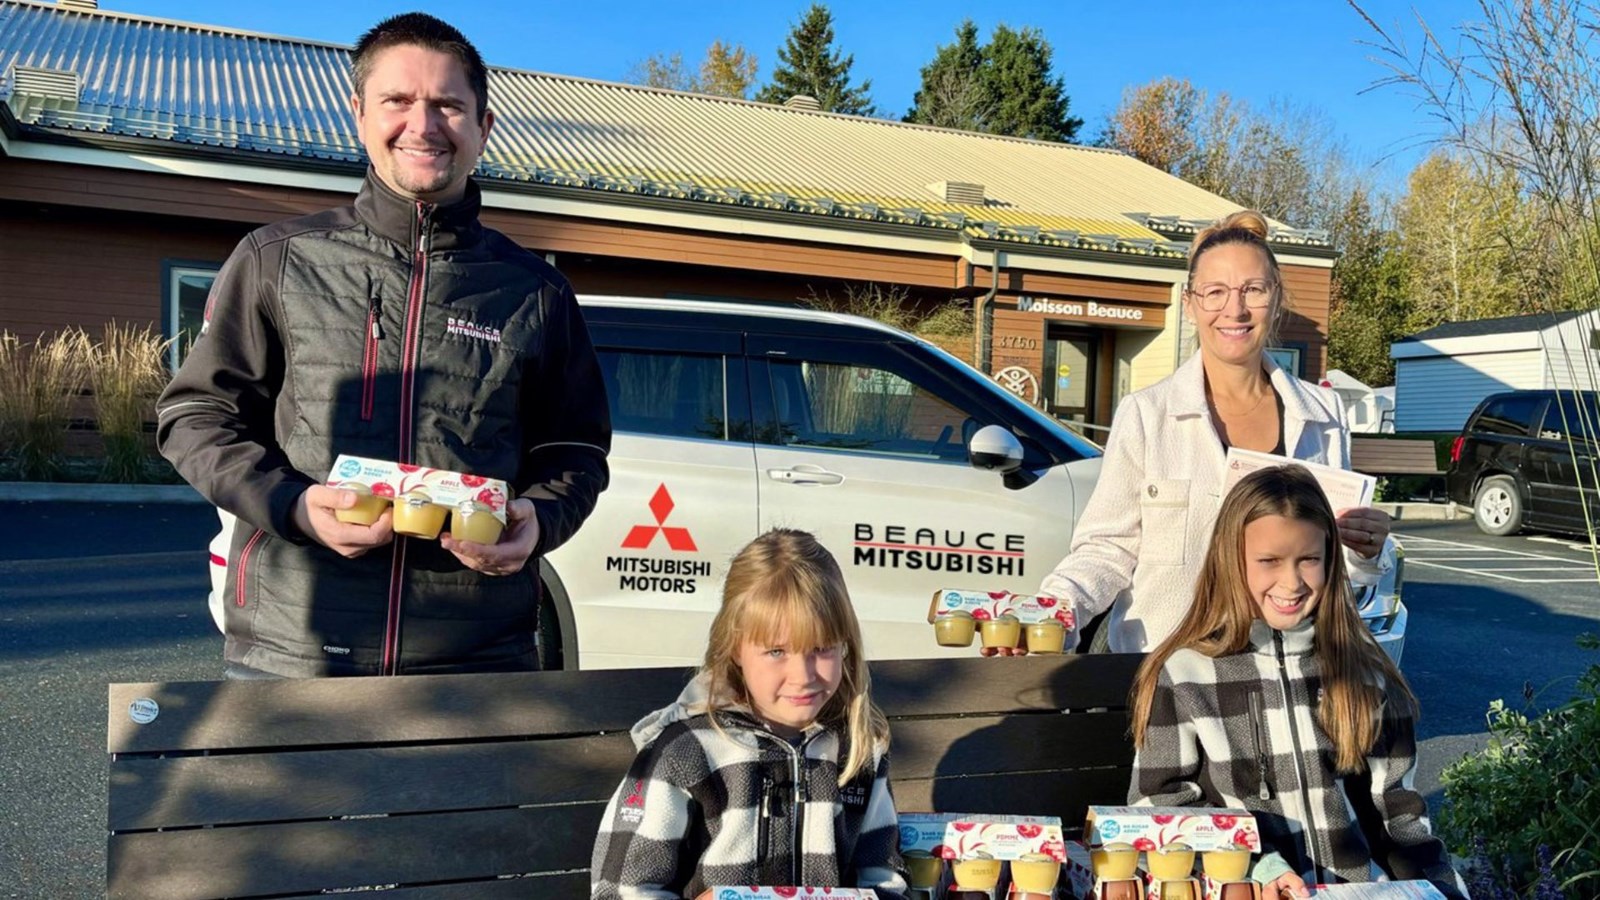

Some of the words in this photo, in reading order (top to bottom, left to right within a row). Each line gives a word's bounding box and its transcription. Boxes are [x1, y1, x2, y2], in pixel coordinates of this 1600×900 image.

[1018, 296, 1082, 315] Moisson
[1087, 302, 1143, 320] Beauce
[447, 317, 500, 336] BEAUCE
[447, 325, 501, 342] MITSUBISHI
[440, 479, 460, 488] APPLE
[854, 523, 1025, 552] BEAUCE
[606, 556, 711, 577] MITSUBISHI
[854, 547, 1024, 576] MITSUBISHI
[620, 575, 696, 594] MOTORS
[996, 833, 1019, 841] POMME
